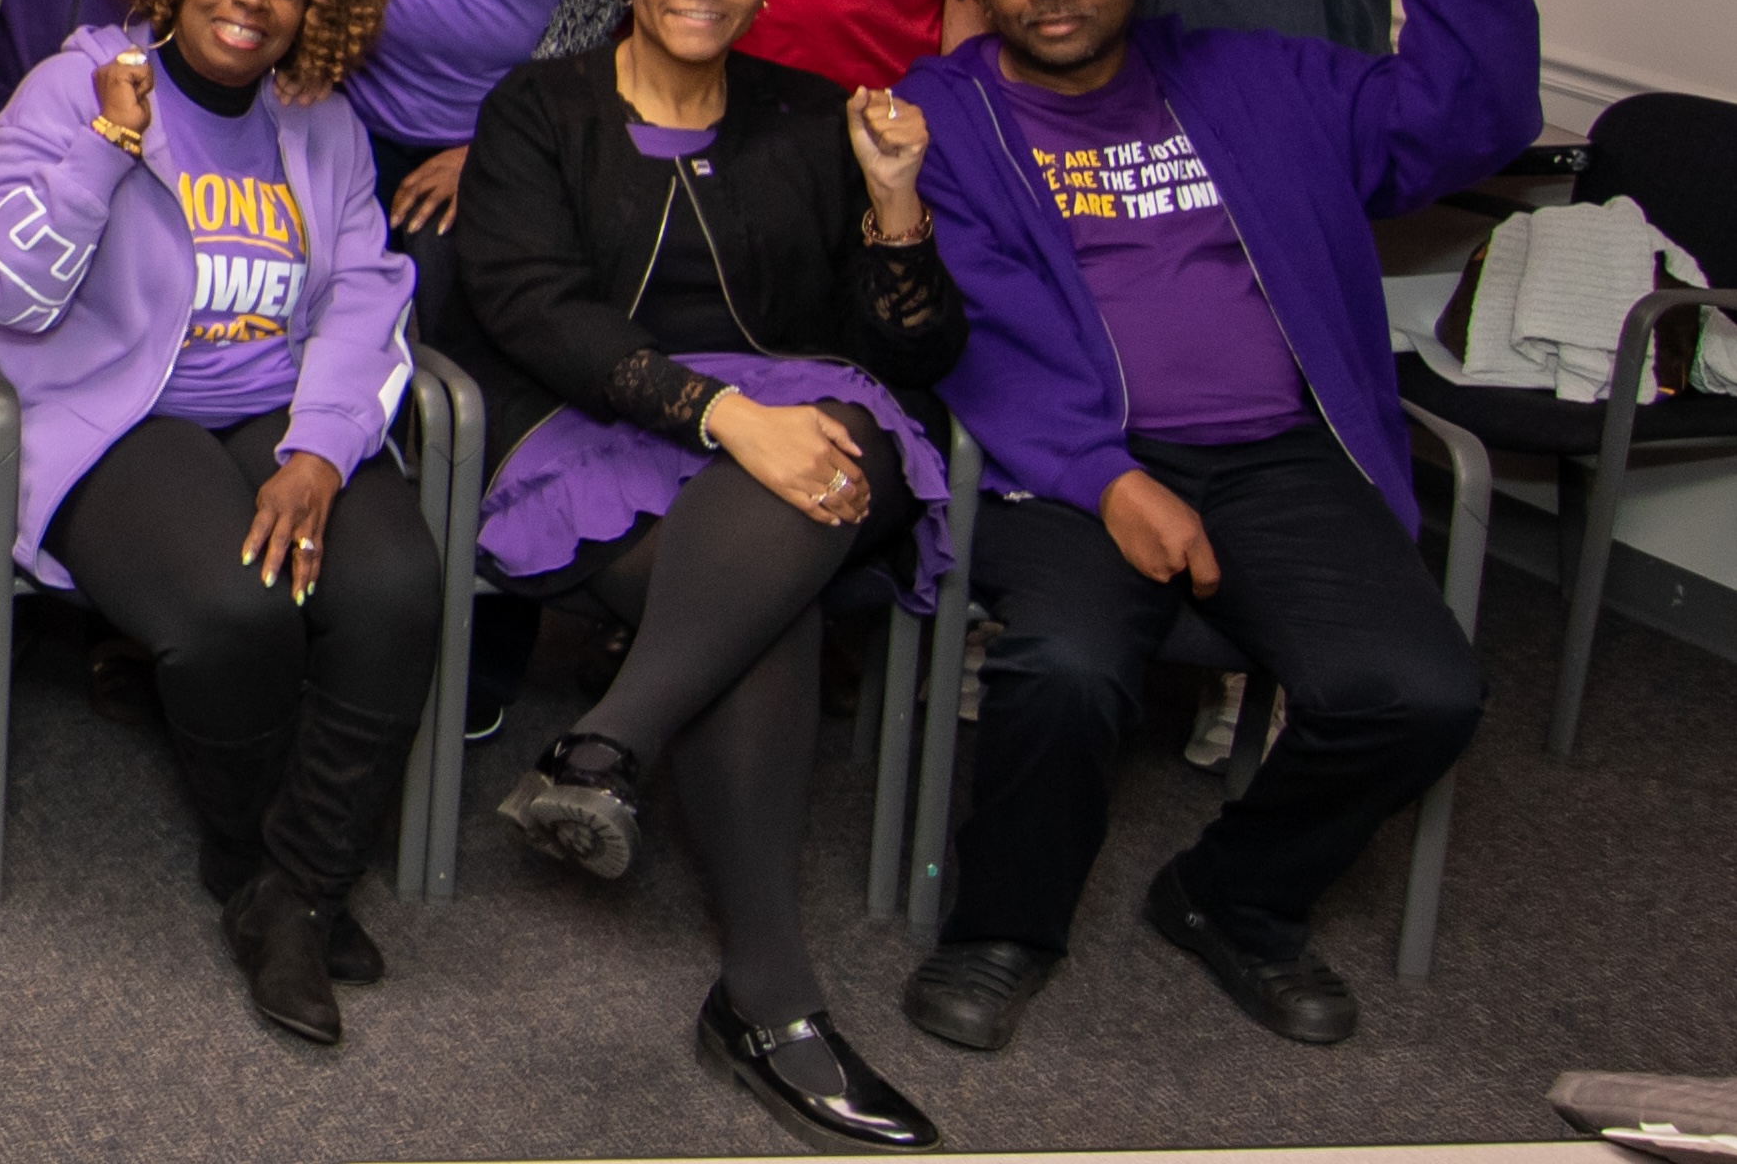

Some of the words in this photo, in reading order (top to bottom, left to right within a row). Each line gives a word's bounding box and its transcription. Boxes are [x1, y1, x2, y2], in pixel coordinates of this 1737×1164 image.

[1065, 149, 1101, 170] ARE
[1103, 141, 1145, 169] THE
[1042, 168, 1061, 191] E
[1063, 170, 1098, 189] ARE
[1099, 168, 1137, 191] THE
[1140, 157, 1208, 188] MOVEM
[1073, 191, 1117, 218] ARE
[1121, 186, 1174, 220] THE
[1176, 180, 1219, 212] UNI
